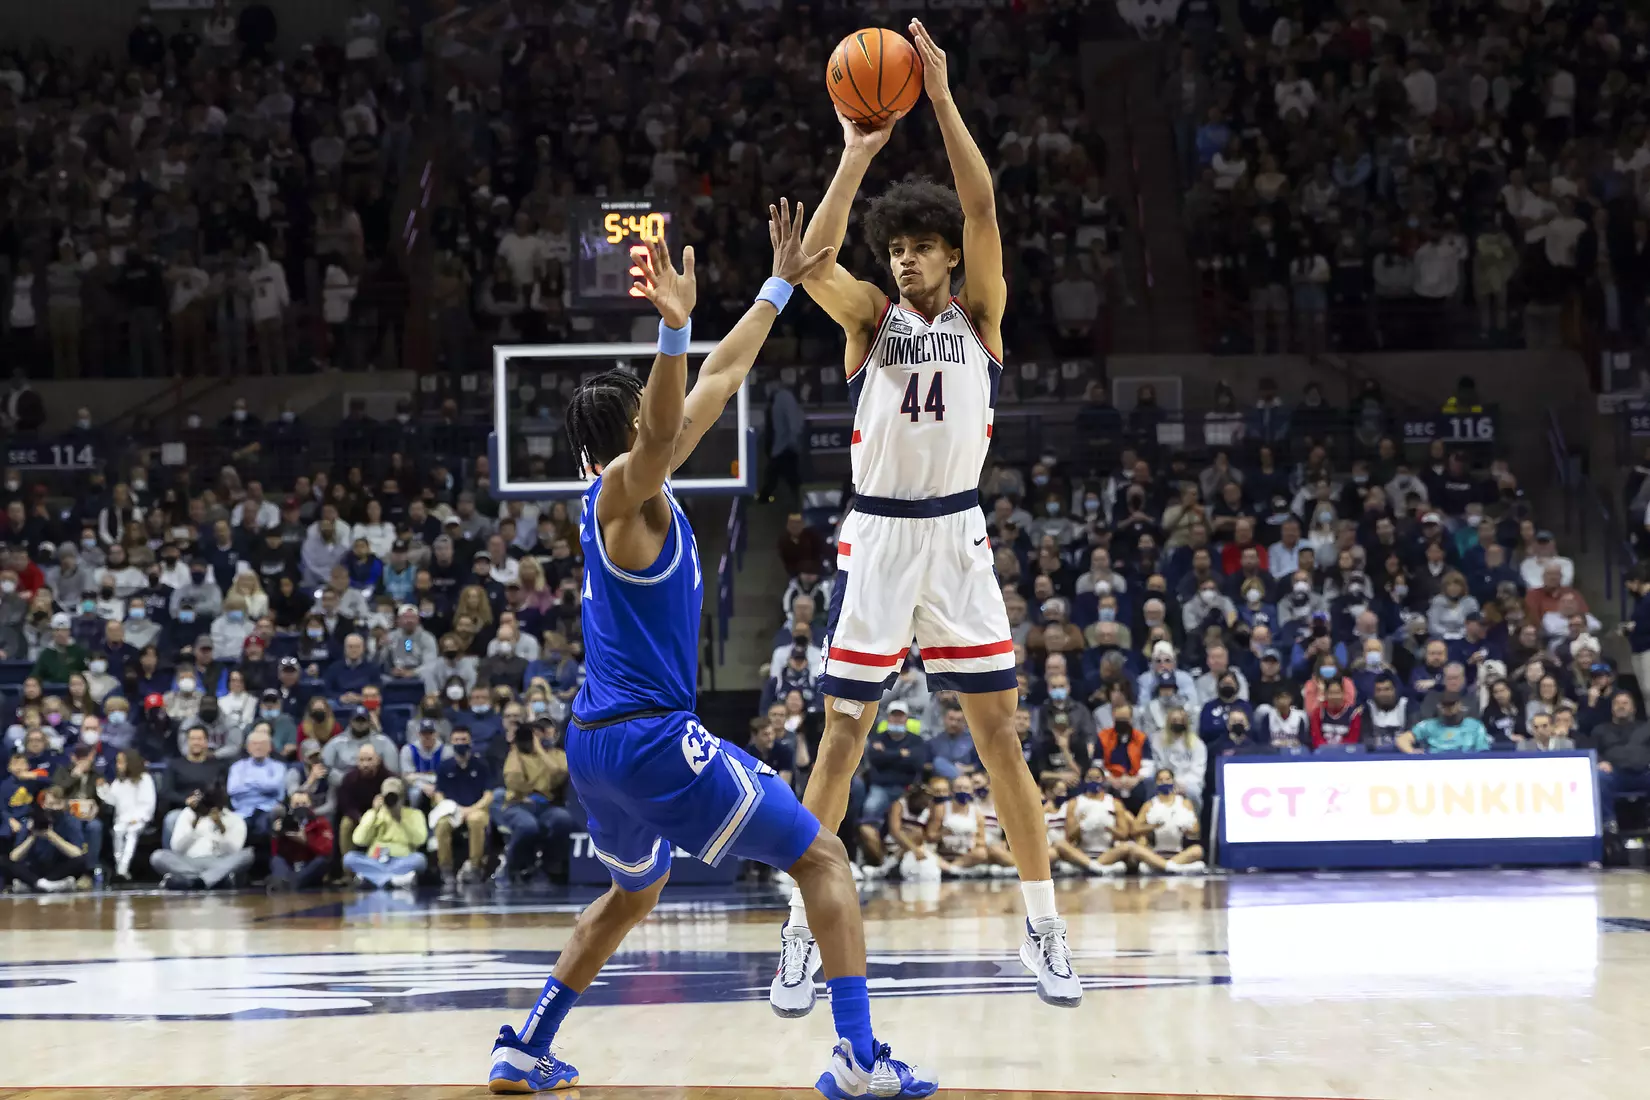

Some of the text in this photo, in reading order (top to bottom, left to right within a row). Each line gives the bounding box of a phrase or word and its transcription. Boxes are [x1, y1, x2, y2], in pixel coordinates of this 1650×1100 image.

[605, 213, 664, 244] 5:40
[900, 371, 945, 422] 44
[1403, 417, 1494, 439] SEC 116
[1630, 416, 1650, 429] SE
[810, 433, 841, 447] SEC
[8, 444, 95, 468] SEC 114
[1241, 781, 1578, 817] CT DUNKIN'
